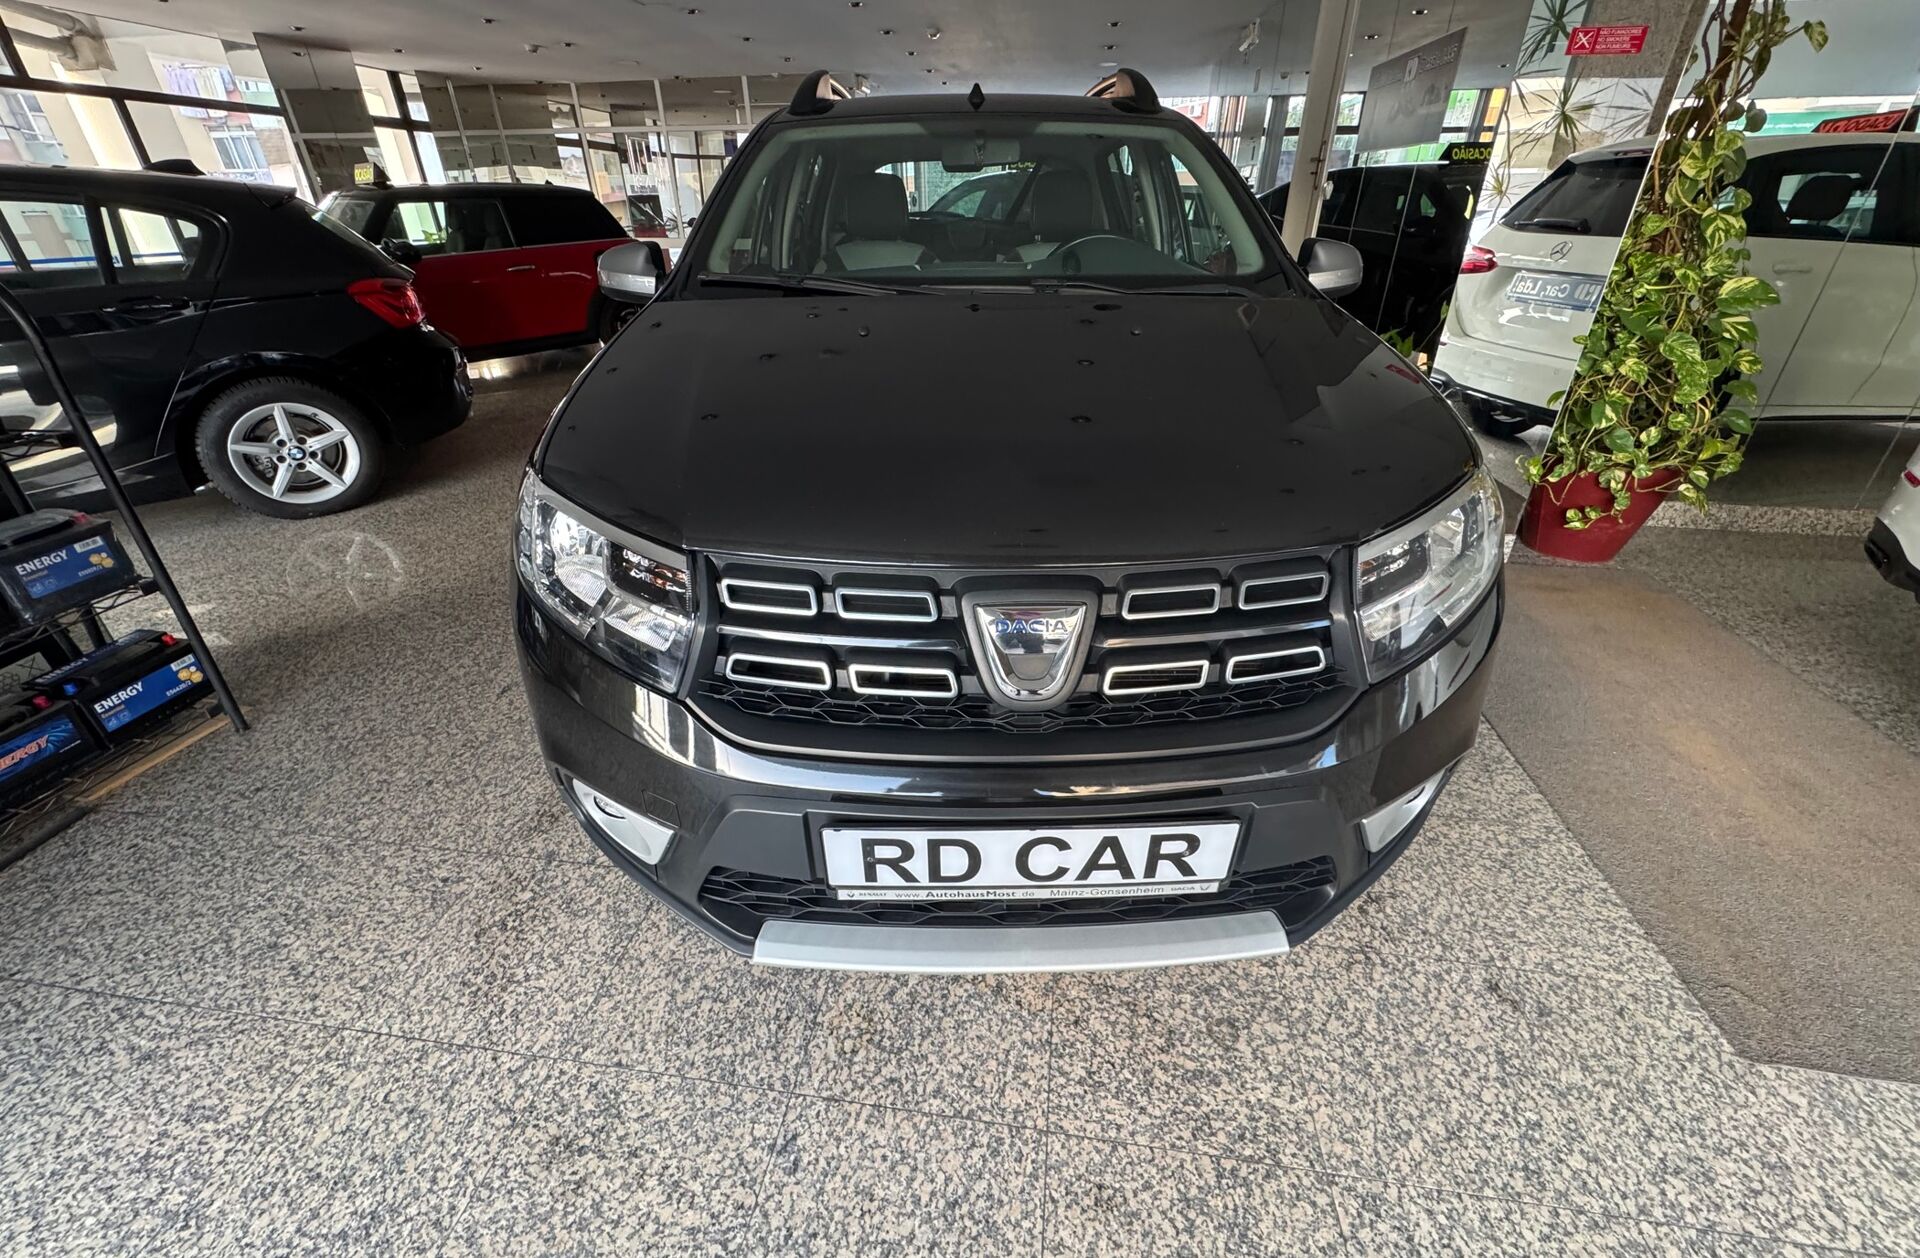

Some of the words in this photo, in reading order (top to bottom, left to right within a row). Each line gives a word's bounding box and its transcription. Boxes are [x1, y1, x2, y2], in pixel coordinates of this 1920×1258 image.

[15, 549, 68, 575] ENERGY
[995, 619, 1068, 634] DACIA
[93, 681, 144, 713] ENERGY
[860, 837, 983, 884] RD
[1014, 833, 1202, 883] CAR
[1049, 887, 1165, 897] Mainz-Gonsenheim
